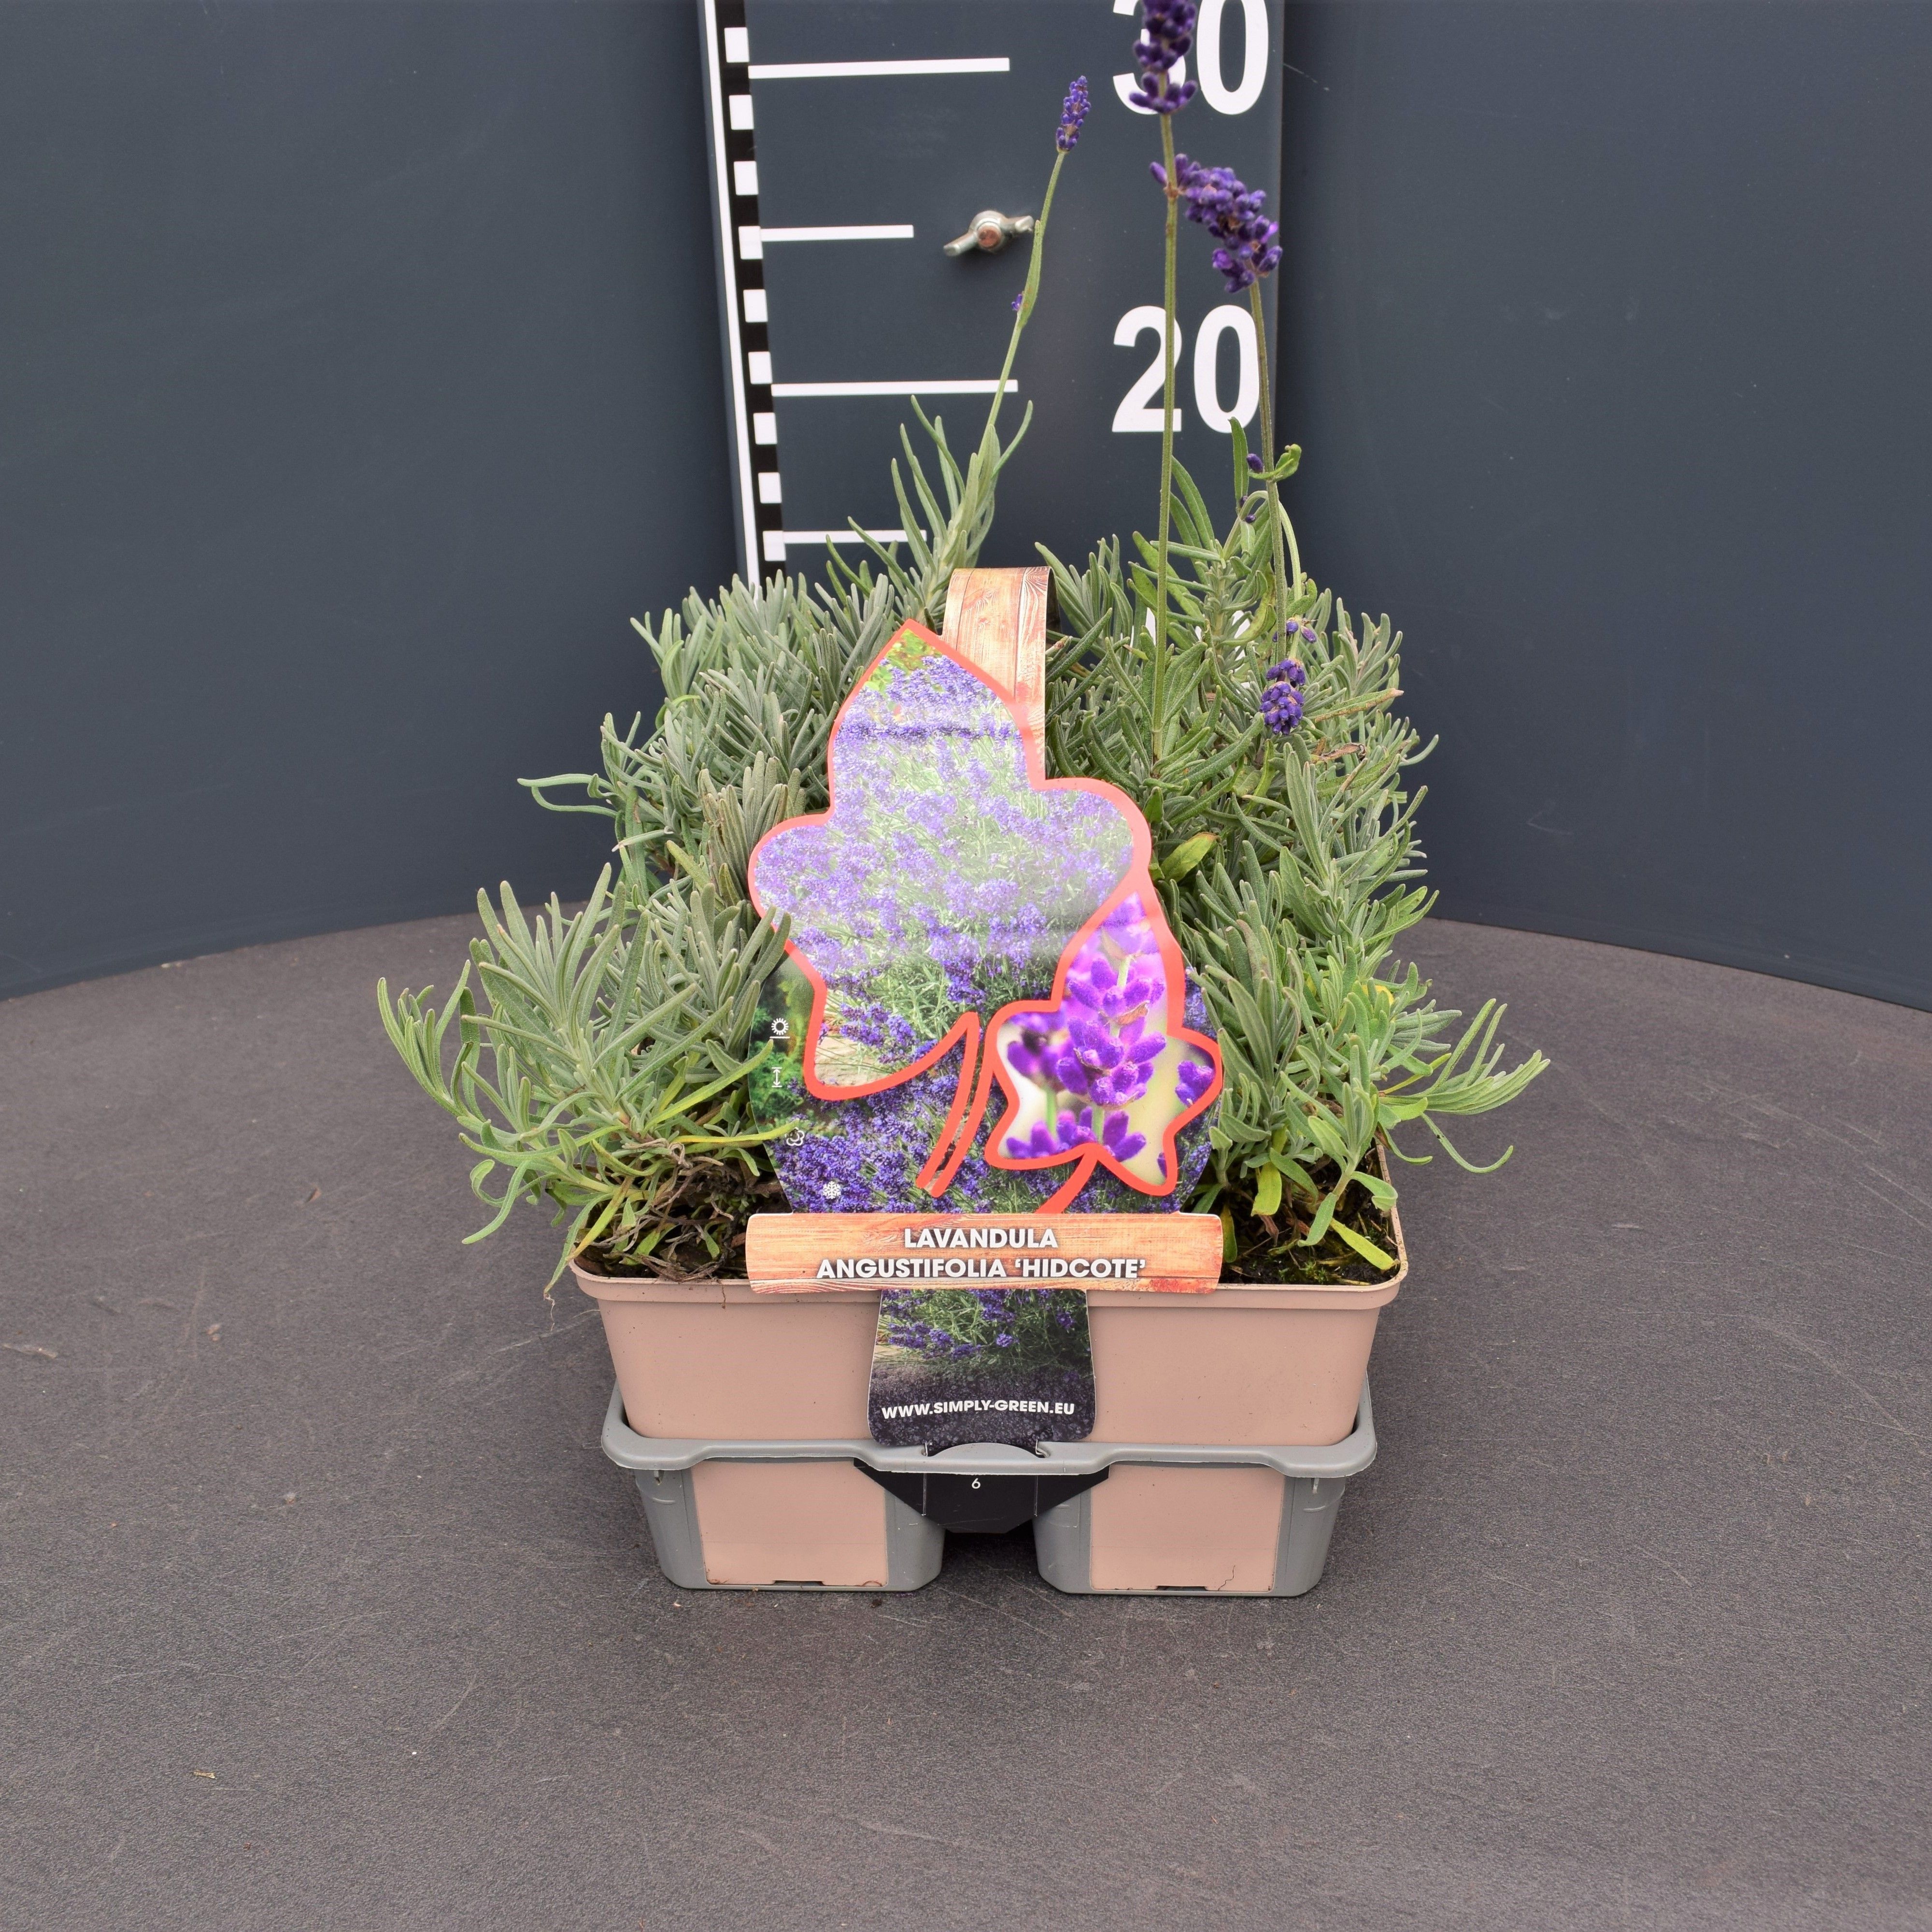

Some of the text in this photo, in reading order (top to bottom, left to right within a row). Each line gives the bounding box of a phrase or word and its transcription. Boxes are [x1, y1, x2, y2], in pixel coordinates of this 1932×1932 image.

[1112, 305, 1260, 433] 20
[904, 1228, 1058, 1249] LAVANDULA
[816, 1258, 1007, 1278] ANGUSTIFOLIA
[881, 1400, 1075, 1419] WWW.SIMPLY-GREEN.EU
[971, 1478, 981, 1489] 6
